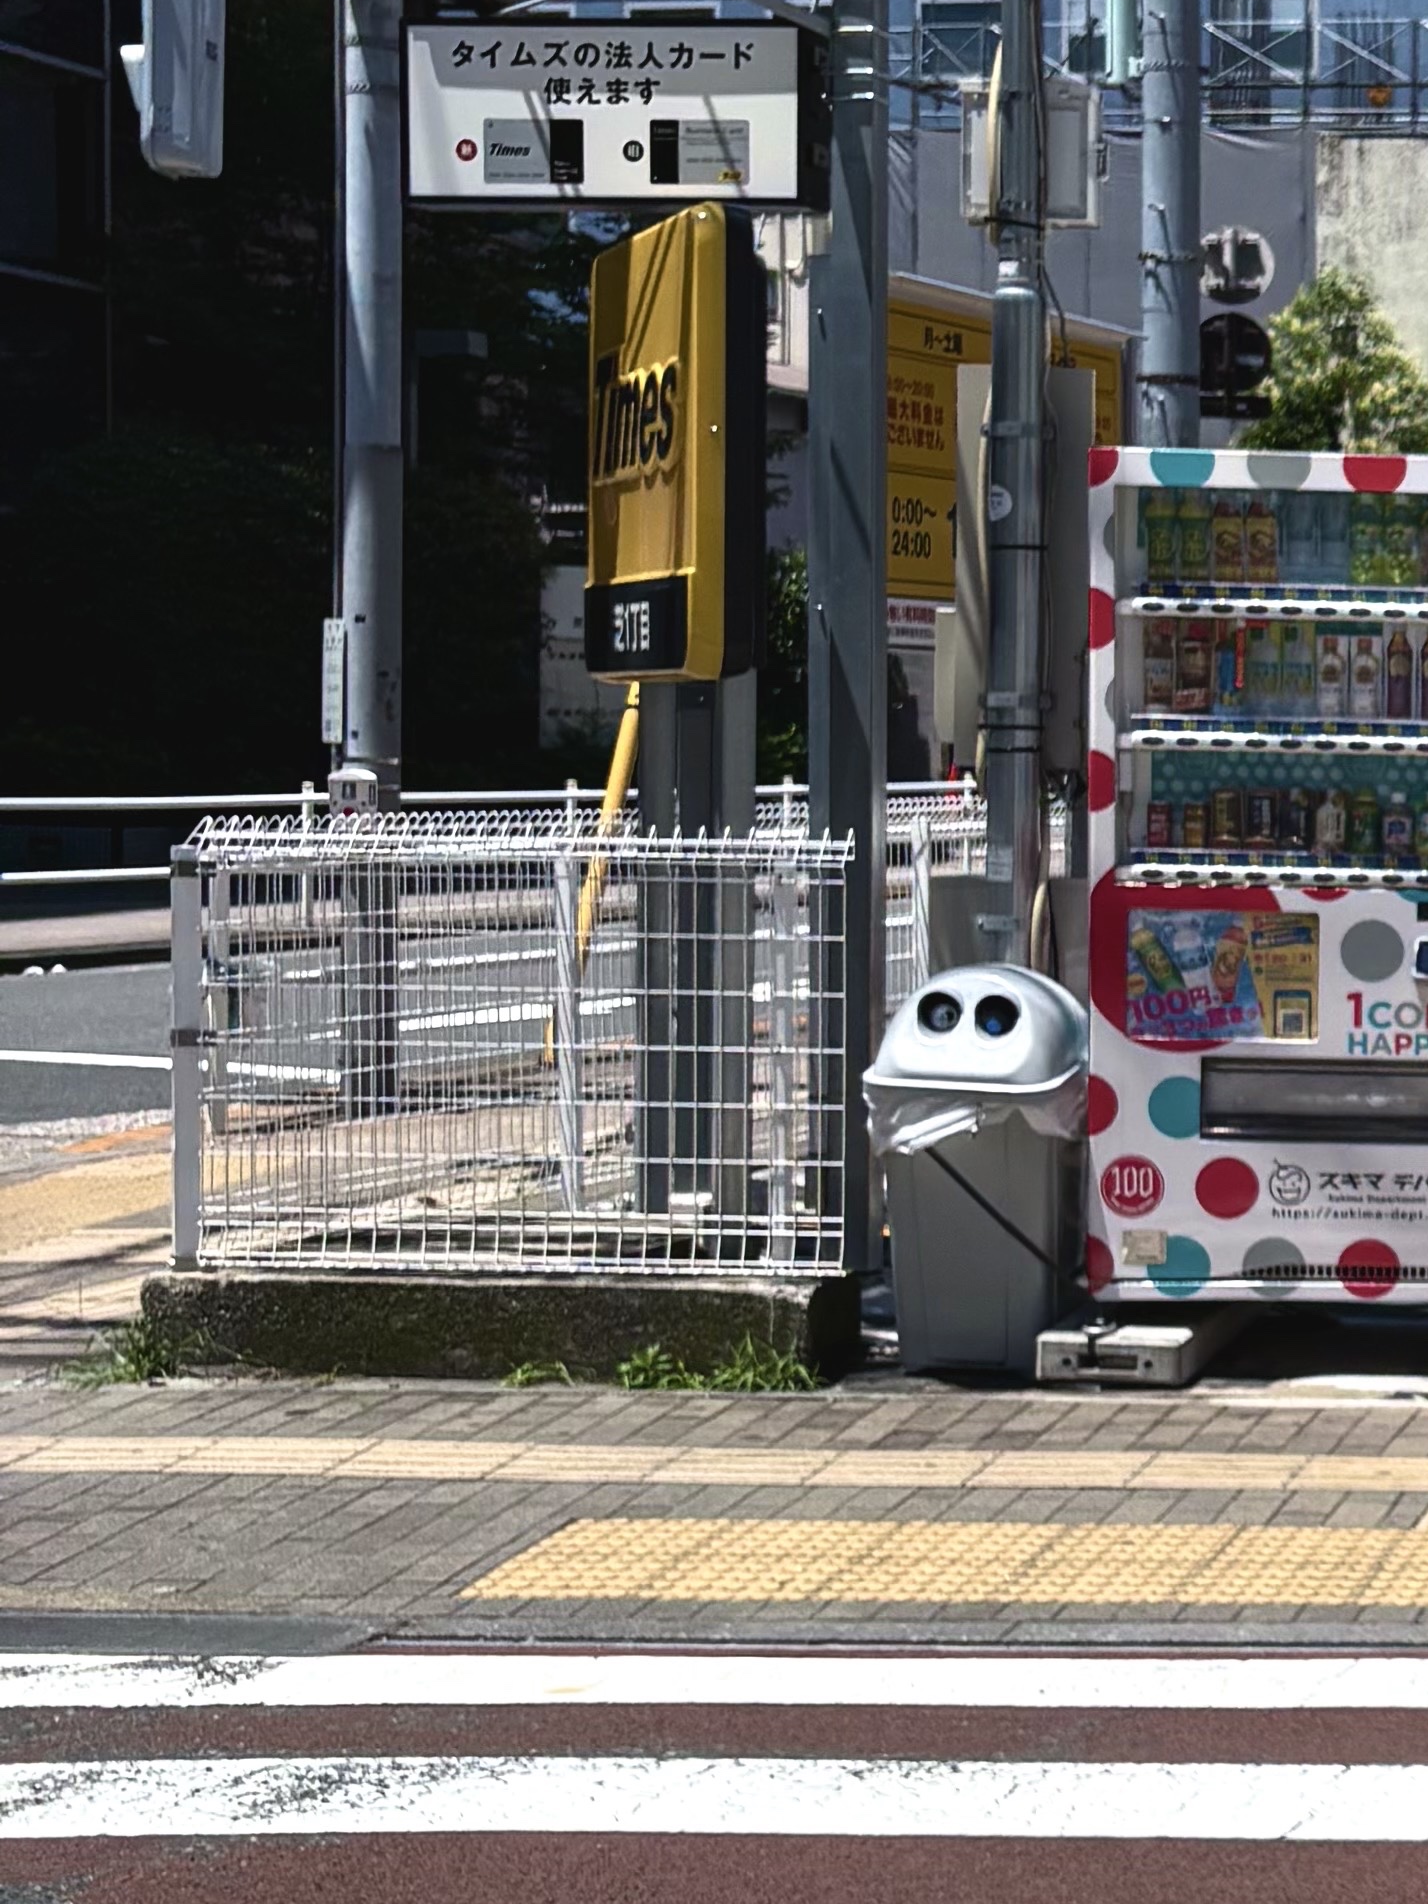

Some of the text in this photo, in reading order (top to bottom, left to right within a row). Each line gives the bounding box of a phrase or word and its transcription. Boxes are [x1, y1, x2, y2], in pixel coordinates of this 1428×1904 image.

[452, 41, 754, 69] タイムズの法人カード
[543, 77, 661, 106] 使えます
[488, 142, 531, 157] Times
[592, 353, 677, 480] Times
[891, 530, 931, 559] 24:00
[1111, 1165, 1154, 1198] 100
[1319, 1173, 1385, 1191] スキマ
